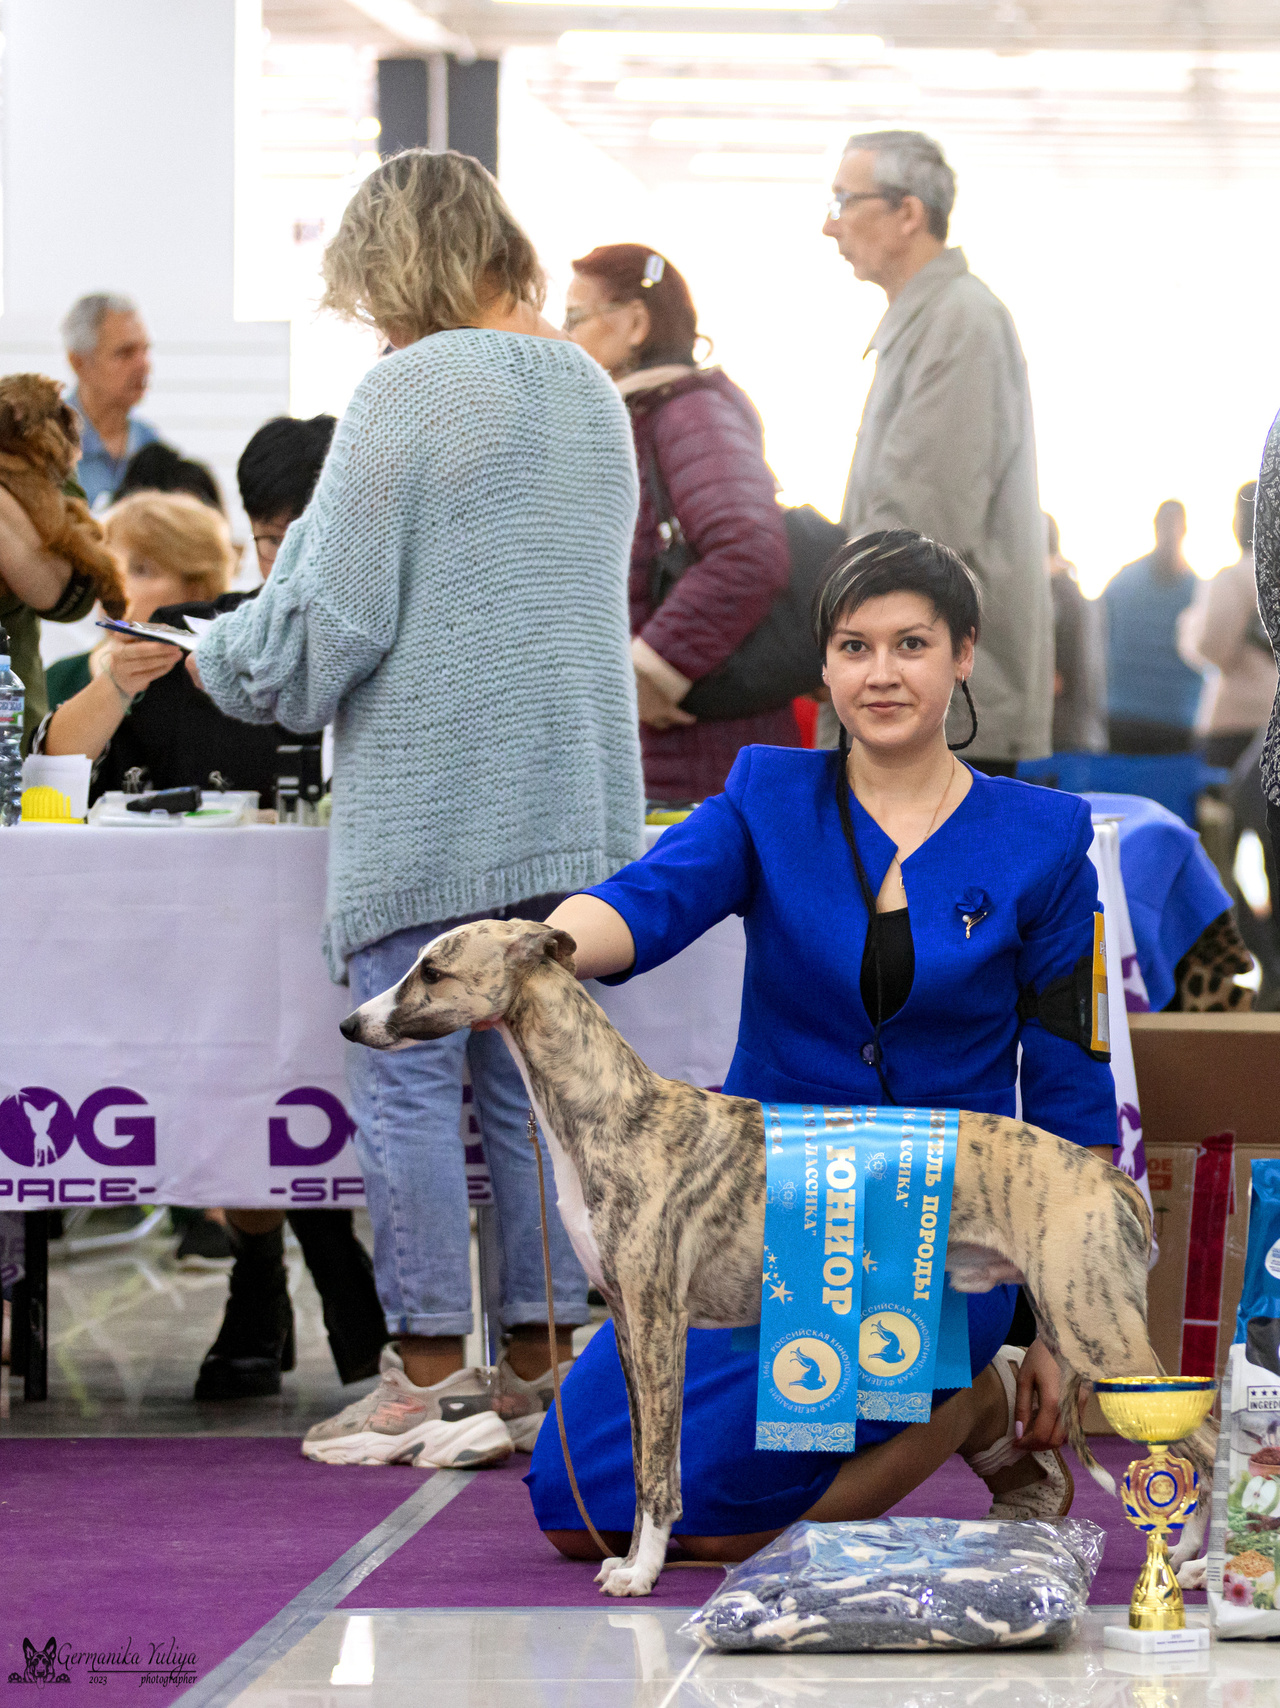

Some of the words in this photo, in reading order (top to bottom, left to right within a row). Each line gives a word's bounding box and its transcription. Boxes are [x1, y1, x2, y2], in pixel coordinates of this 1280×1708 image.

[0, 1086, 156, 1167] OG
[822, 1145, 857, 1315] ЮНИОР
[912, 1195, 940, 1301] ПОРОДЫ
[770, 1328, 830, 1353] РОССИЙСКАЯ
[819, 1338, 852, 1411] КИНОЛОГИЧЕСКАЯ
[860, 1303, 912, 1320] ССИЙСКАЯ
[911, 1312, 931, 1384] КИНОЛОГИЧЕСКАЯ
[768, 1387, 817, 1414] ФЕДЕРАЦИЯ
